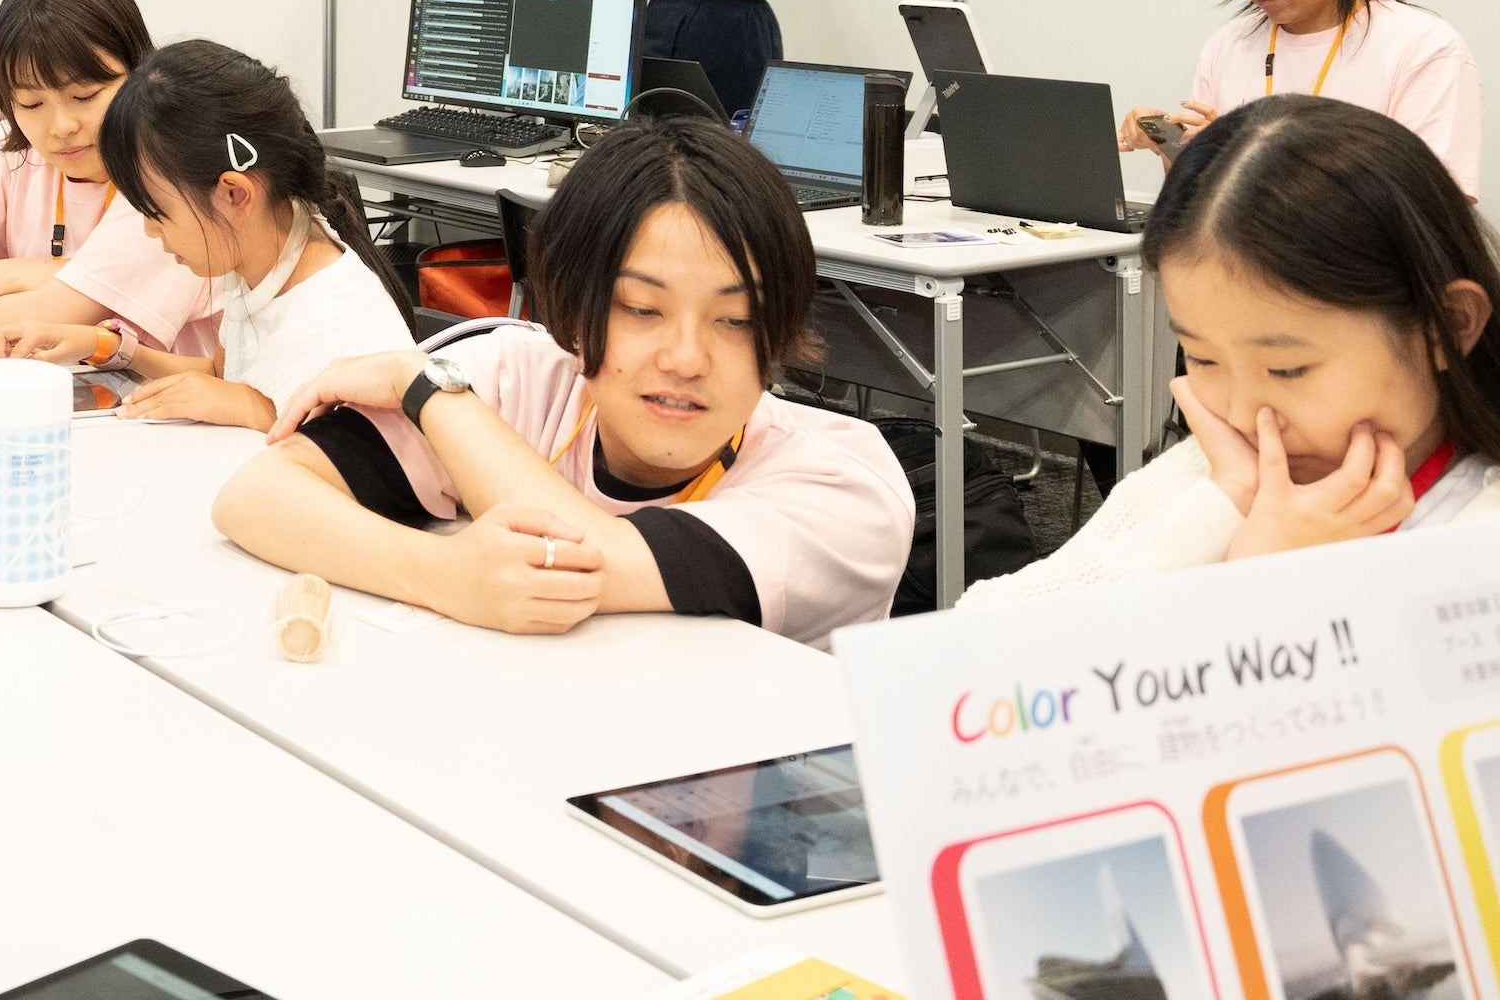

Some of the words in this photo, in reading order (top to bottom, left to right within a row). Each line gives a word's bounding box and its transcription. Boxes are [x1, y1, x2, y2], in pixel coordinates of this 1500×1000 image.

[950, 684, 1079, 745] Color
[1092, 660, 1214, 713] Your
[1227, 638, 1318, 688] Way
